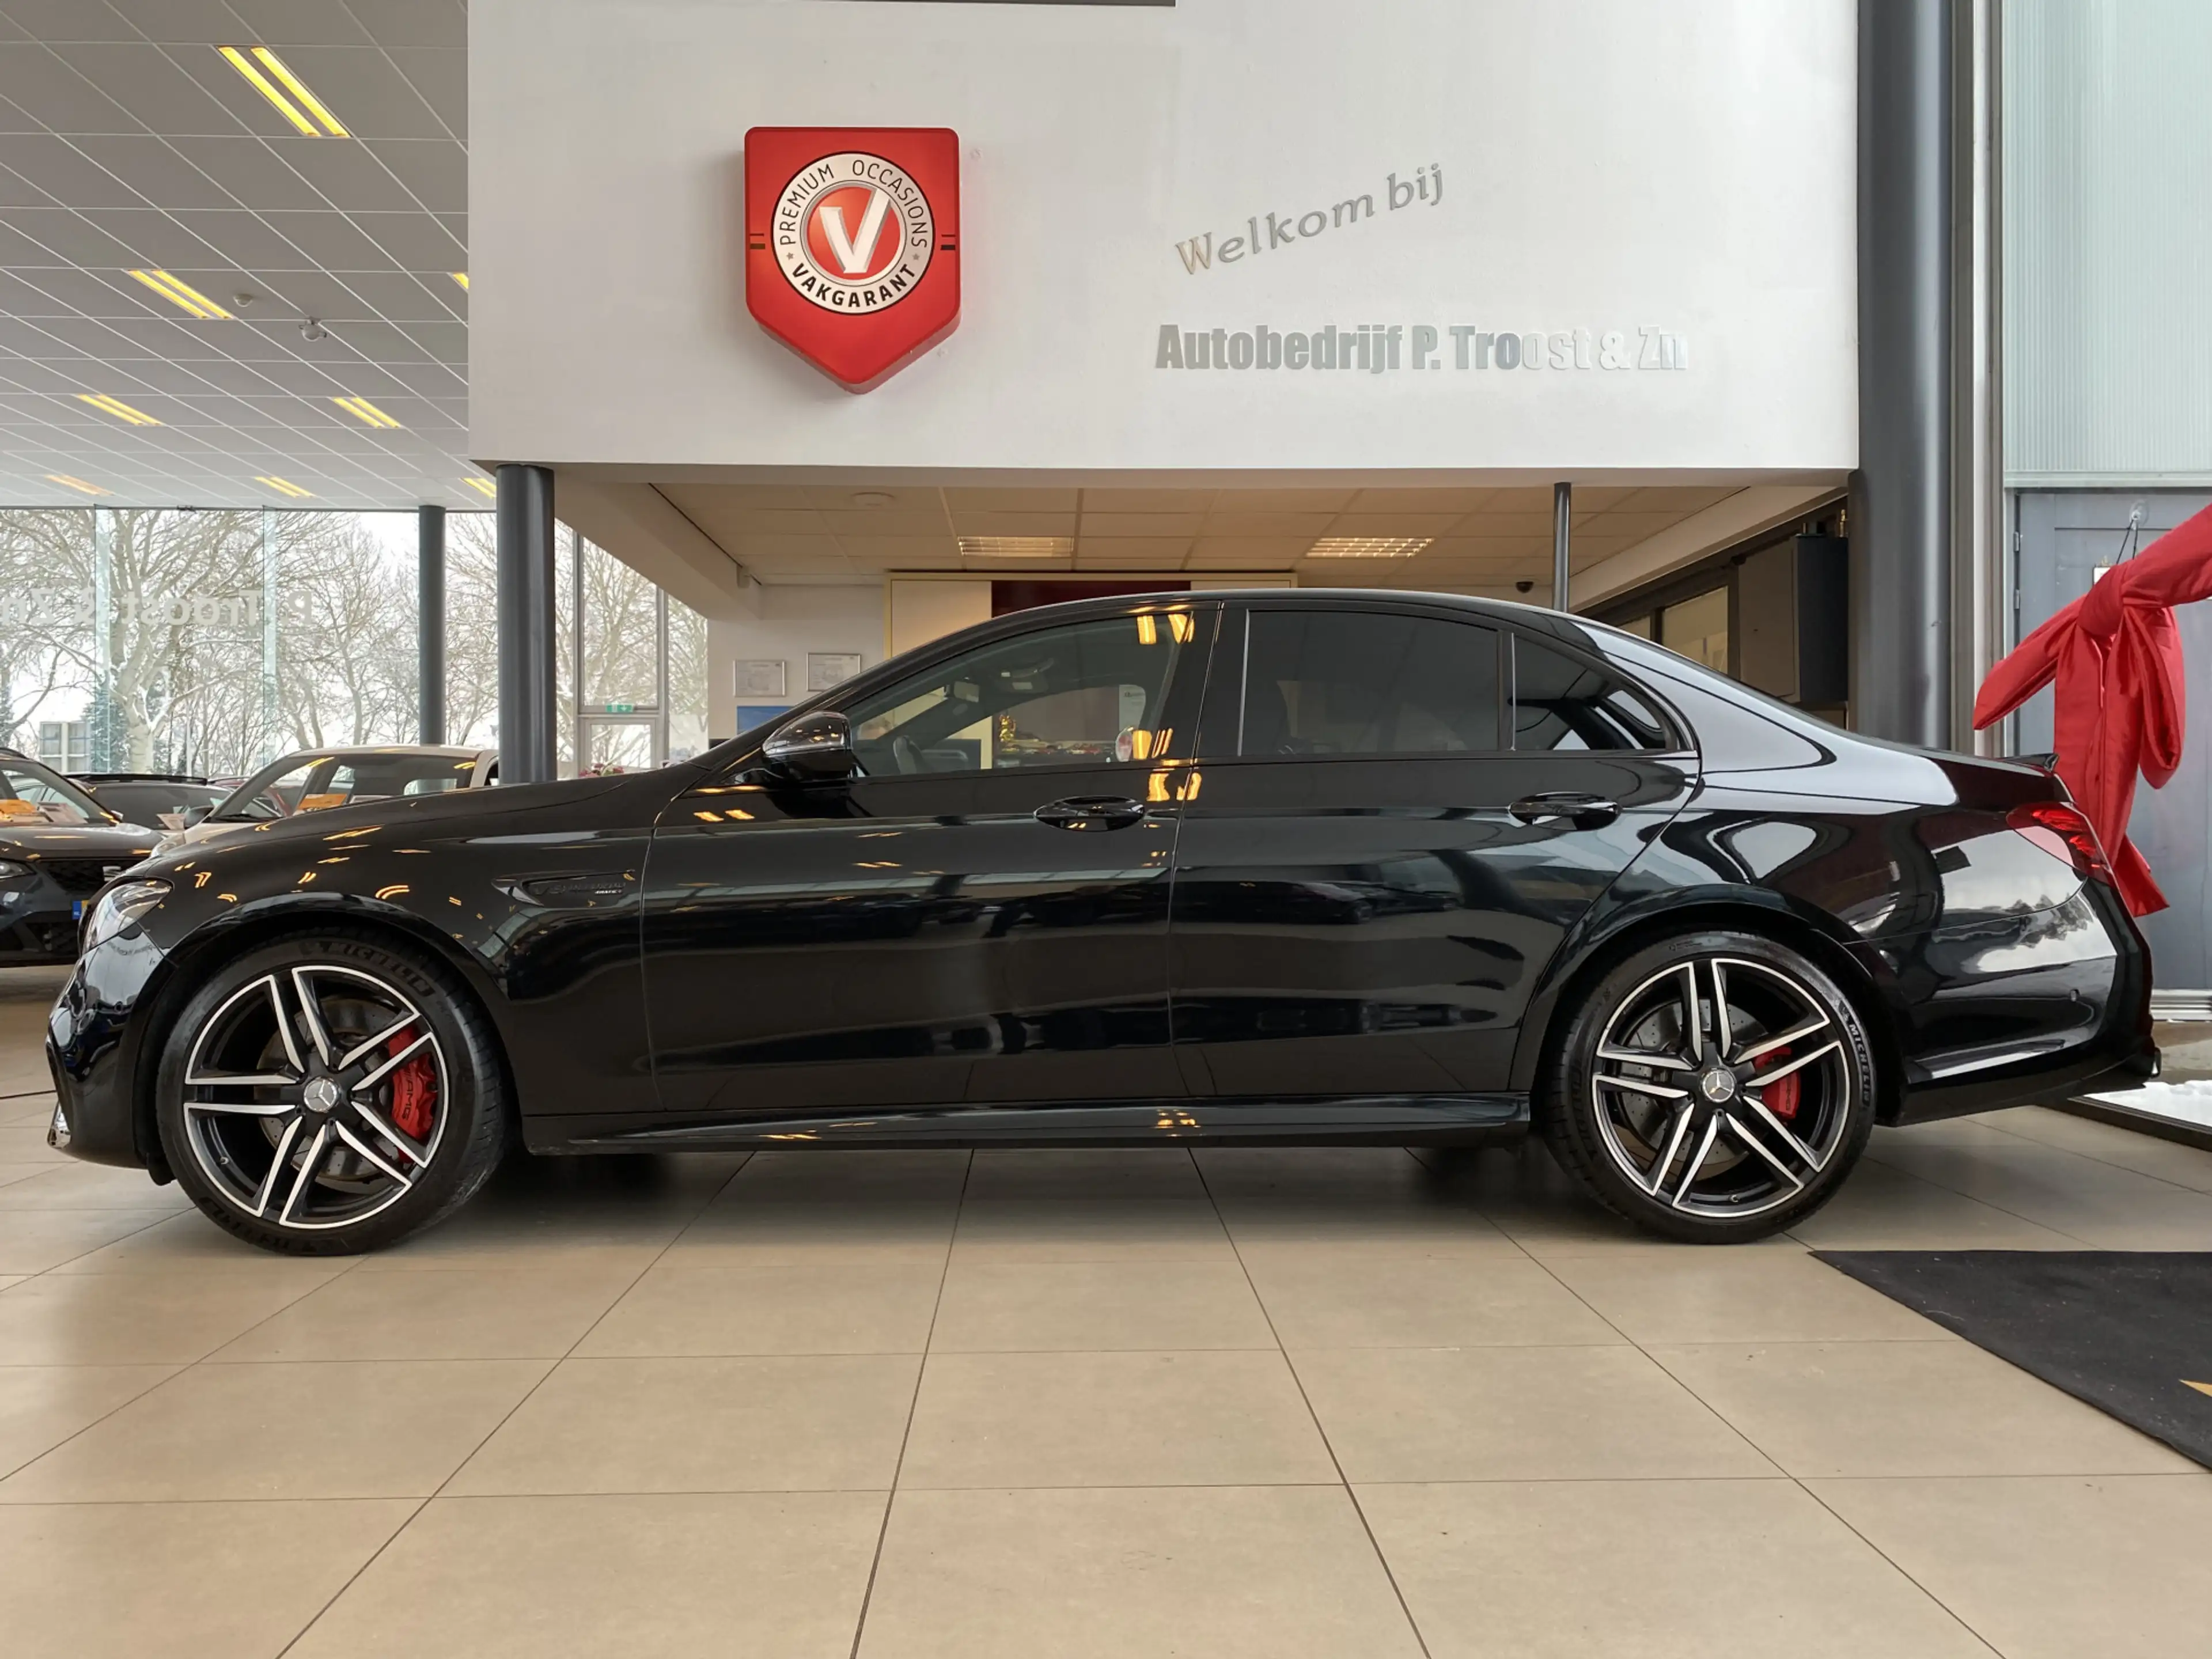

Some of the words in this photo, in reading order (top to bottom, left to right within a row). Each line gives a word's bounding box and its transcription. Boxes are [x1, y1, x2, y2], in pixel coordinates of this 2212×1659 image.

[779, 164, 834, 245] PREMIUM
[852, 160, 928, 248] OCCASIONS
[820, 188, 891, 274] V
[1175, 194, 1375, 275] Welkom
[1387, 163, 1443, 210] bij
[792, 263, 915, 308] VAKGARANT
[1156, 324, 1403, 374] Autobedrijf
[1412, 325, 1441, 370] P.
[1449, 325, 1592, 370] Troost
[1600, 331, 1631, 370] &
[1638, 325, 1687, 370] Zn
[1849, 1024, 1871, 1105] MICHELIN
